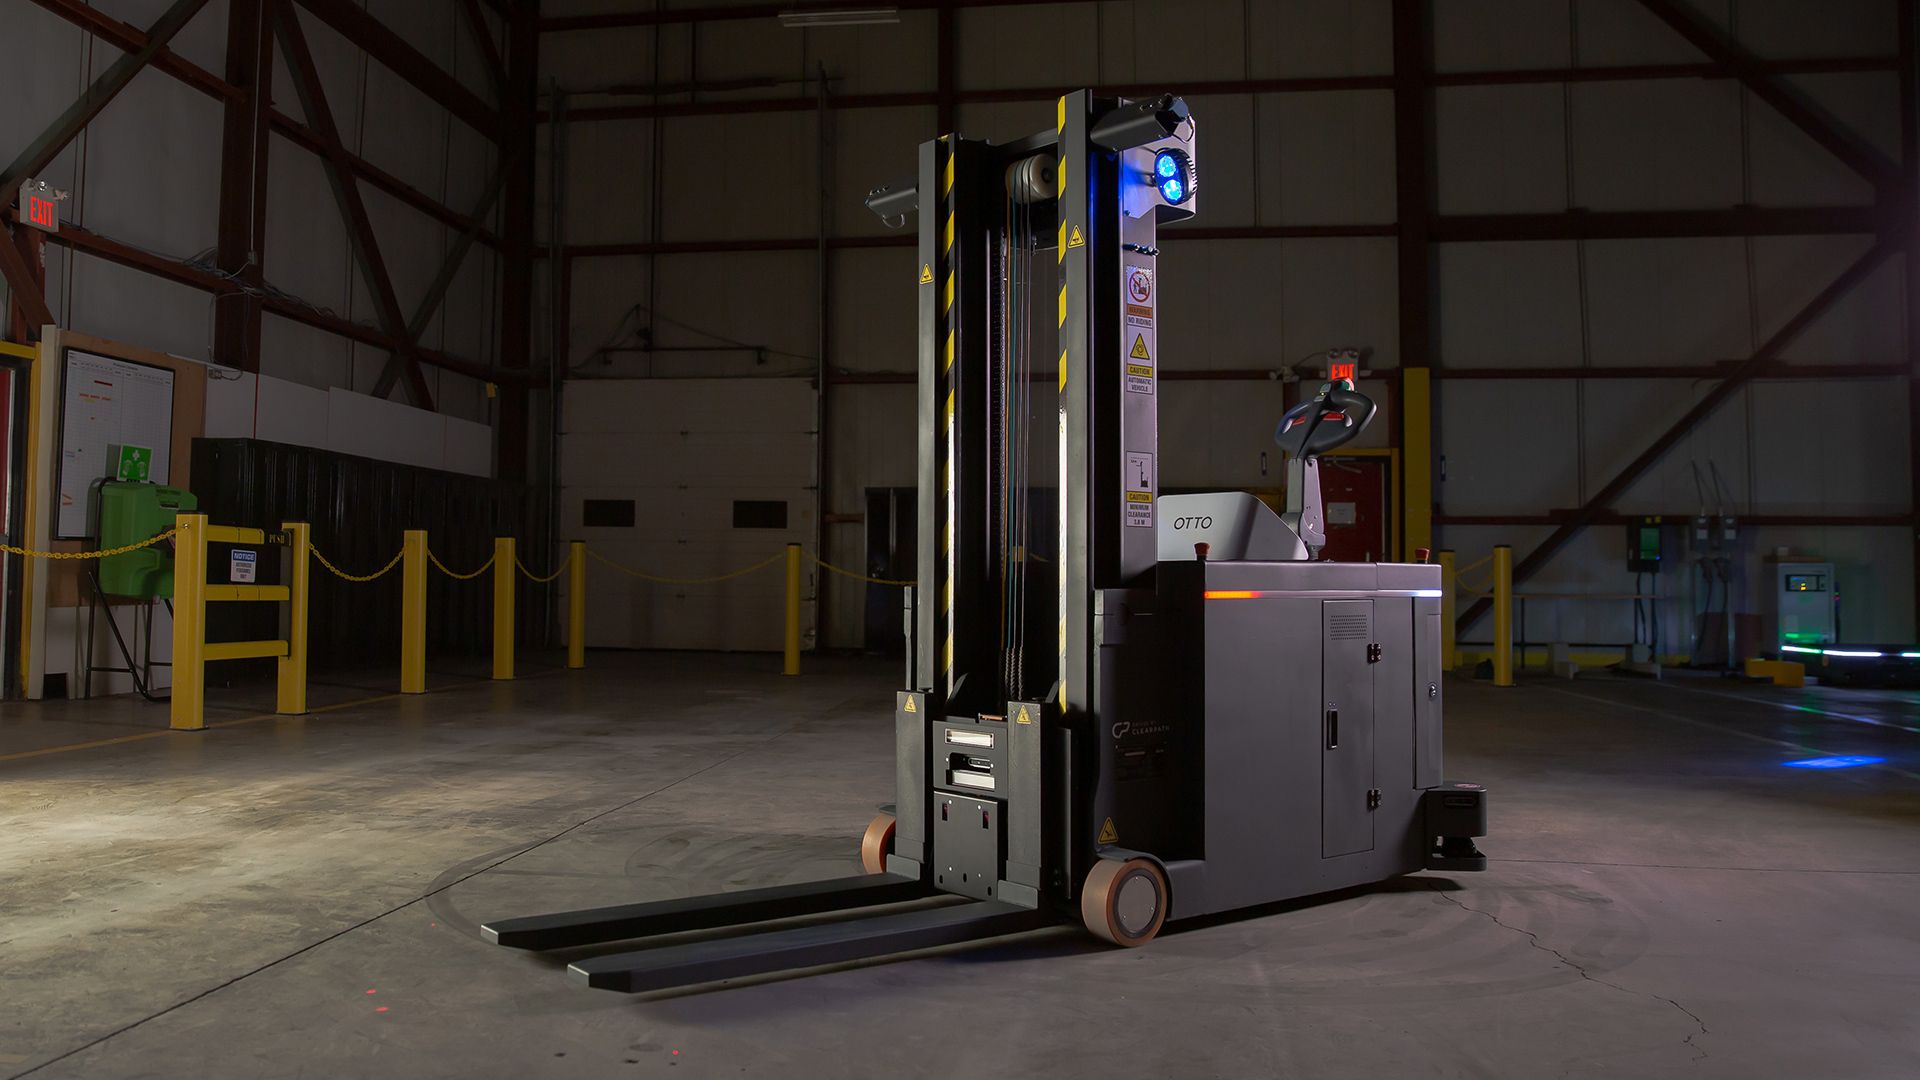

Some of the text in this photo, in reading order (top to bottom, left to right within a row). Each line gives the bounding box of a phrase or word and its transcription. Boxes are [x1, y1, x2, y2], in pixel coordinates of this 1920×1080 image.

[31, 196, 54, 227] EXIT
[1129, 366, 1150, 375] CAUTION
[1331, 364, 1355, 380] EXIT
[1129, 493, 1150, 501] CAUTION
[1173, 516, 1213, 530] OTTO
[233, 552, 255, 561] NOTICE
